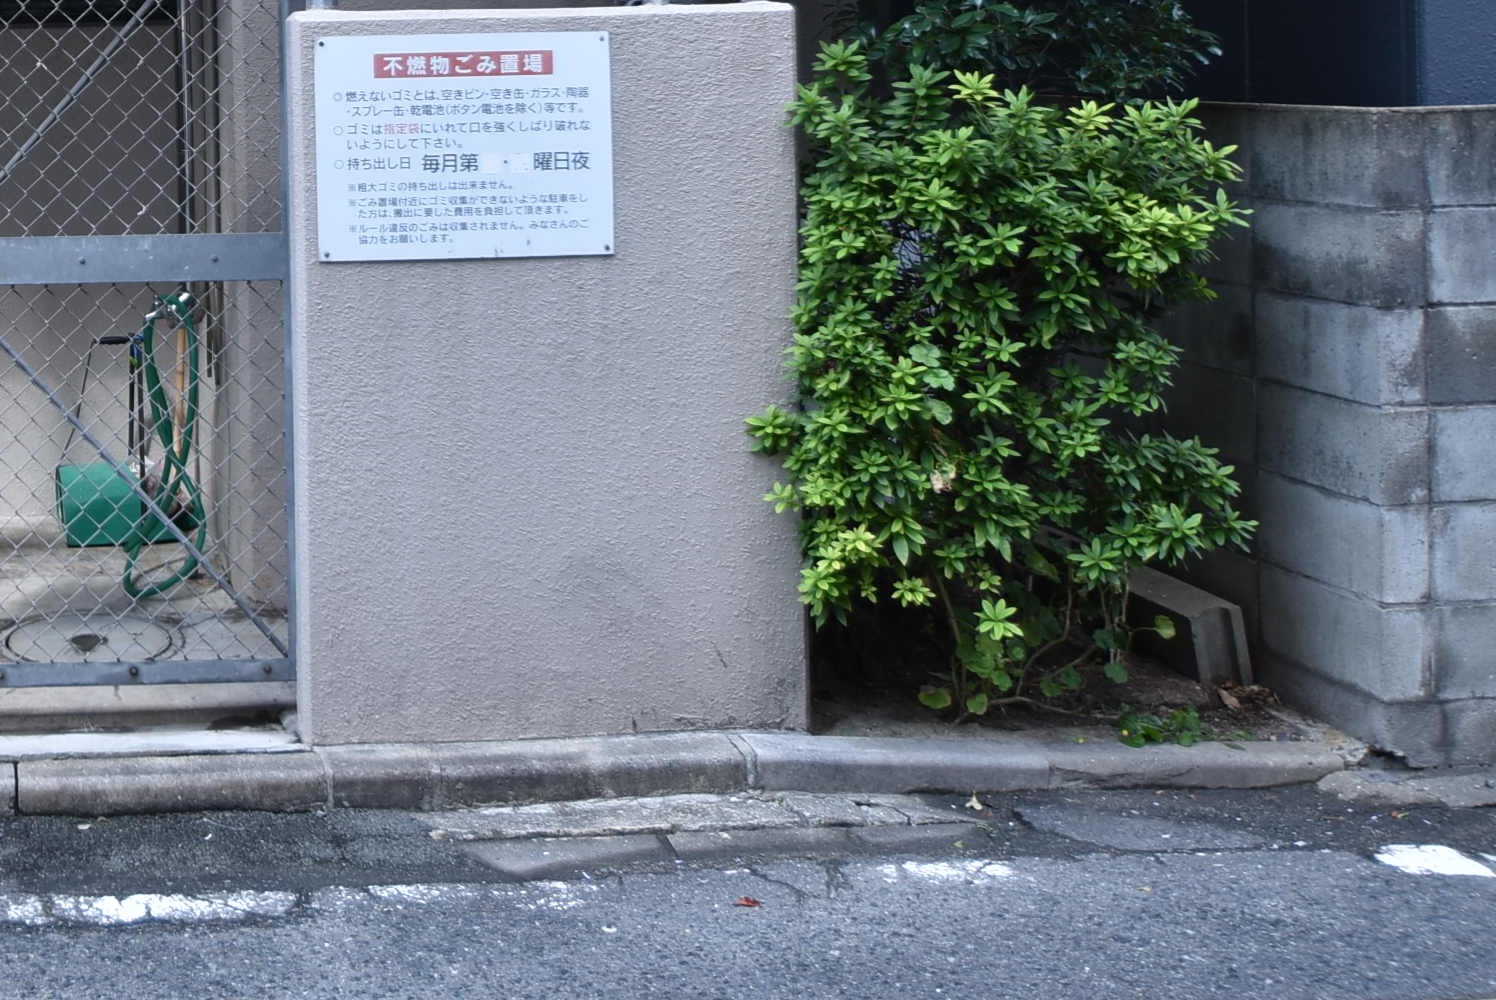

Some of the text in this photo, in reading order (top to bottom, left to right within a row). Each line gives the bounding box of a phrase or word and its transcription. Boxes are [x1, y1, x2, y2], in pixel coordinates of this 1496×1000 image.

[384, 54, 544, 76] 不燃物ごみ置場
[347, 138, 464, 150] いようにして下さい。
[348, 157, 411, 170] 持ち出し日
[358, 234, 454, 245] 協力をお願いします。
